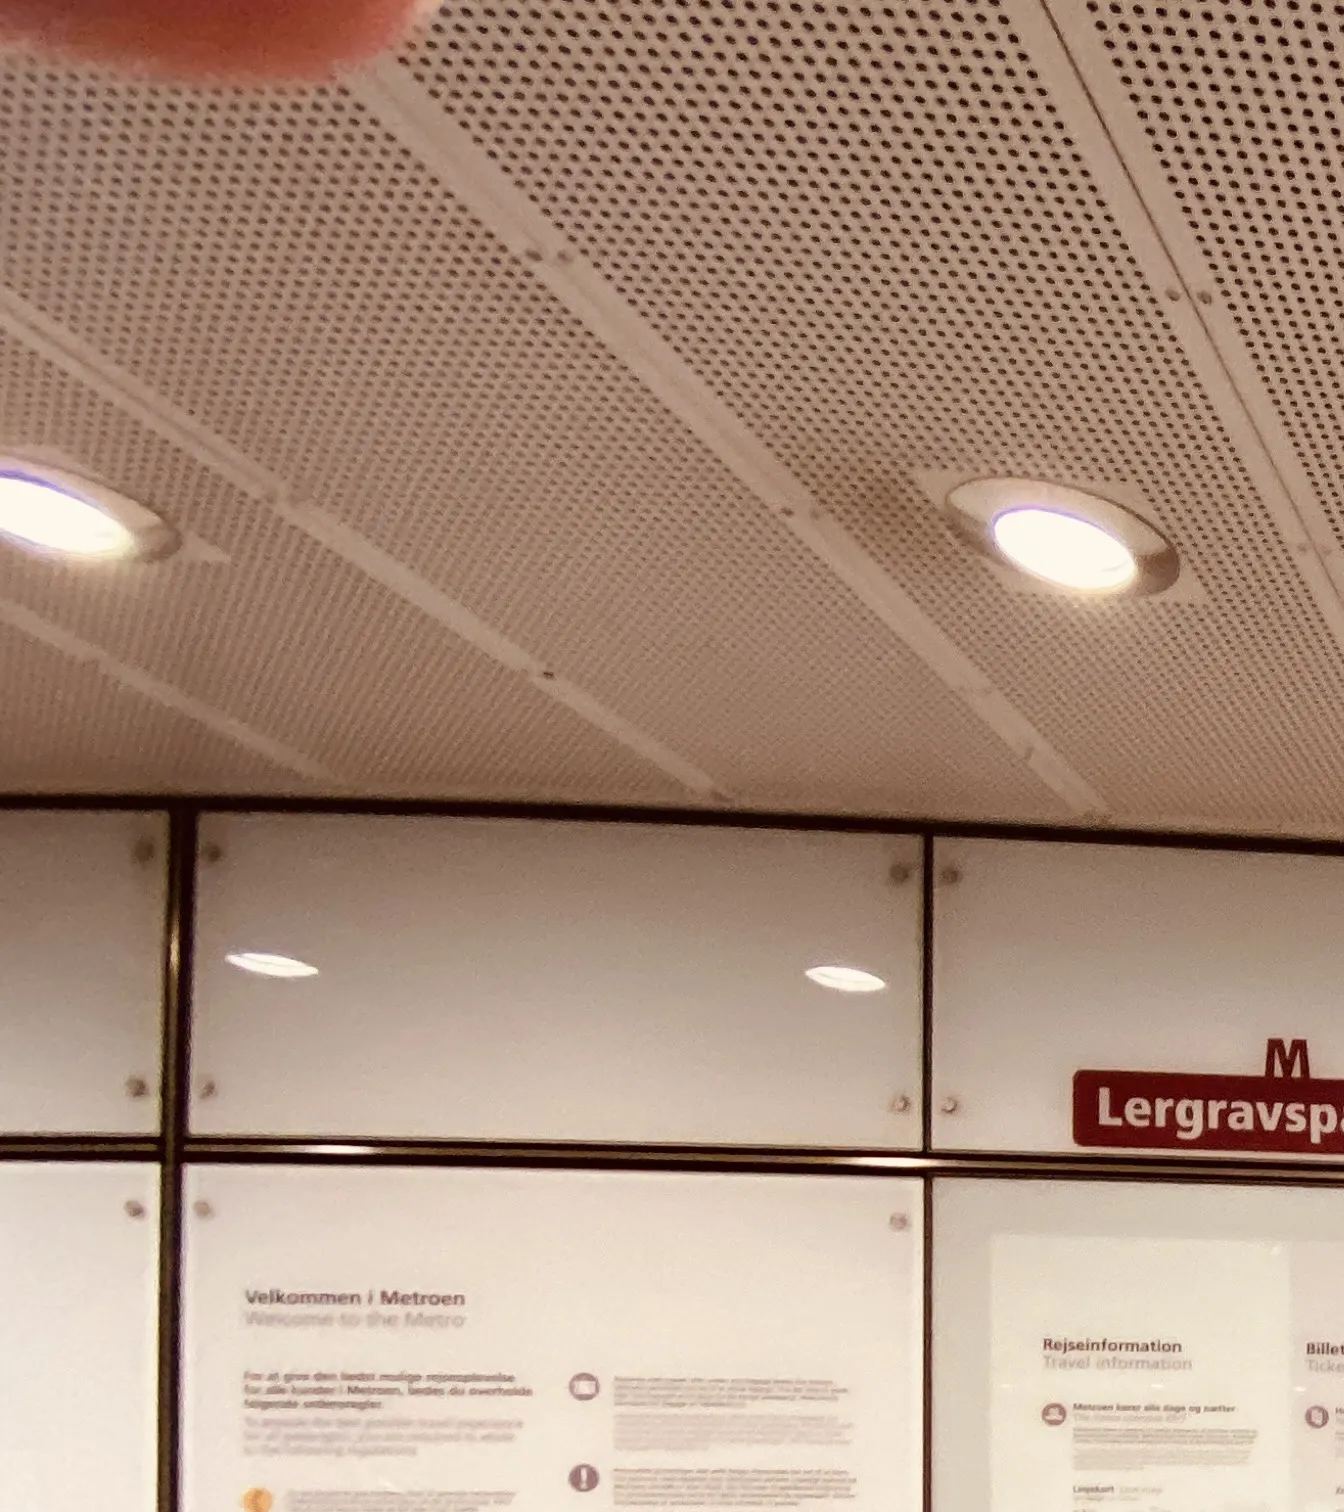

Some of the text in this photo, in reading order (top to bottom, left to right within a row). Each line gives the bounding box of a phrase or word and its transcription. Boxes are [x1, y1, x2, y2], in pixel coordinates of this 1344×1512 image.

[1265, 1038, 1310, 1078] M
[245, 1289, 466, 1306] Velkommen i Metroen
[367, 1311, 398, 1328] the
[404, 1311, 466, 1328] Metro
[1042, 1338, 1183, 1354] Rejseinformation
[1043, 1356, 1193, 1371] Travel information
